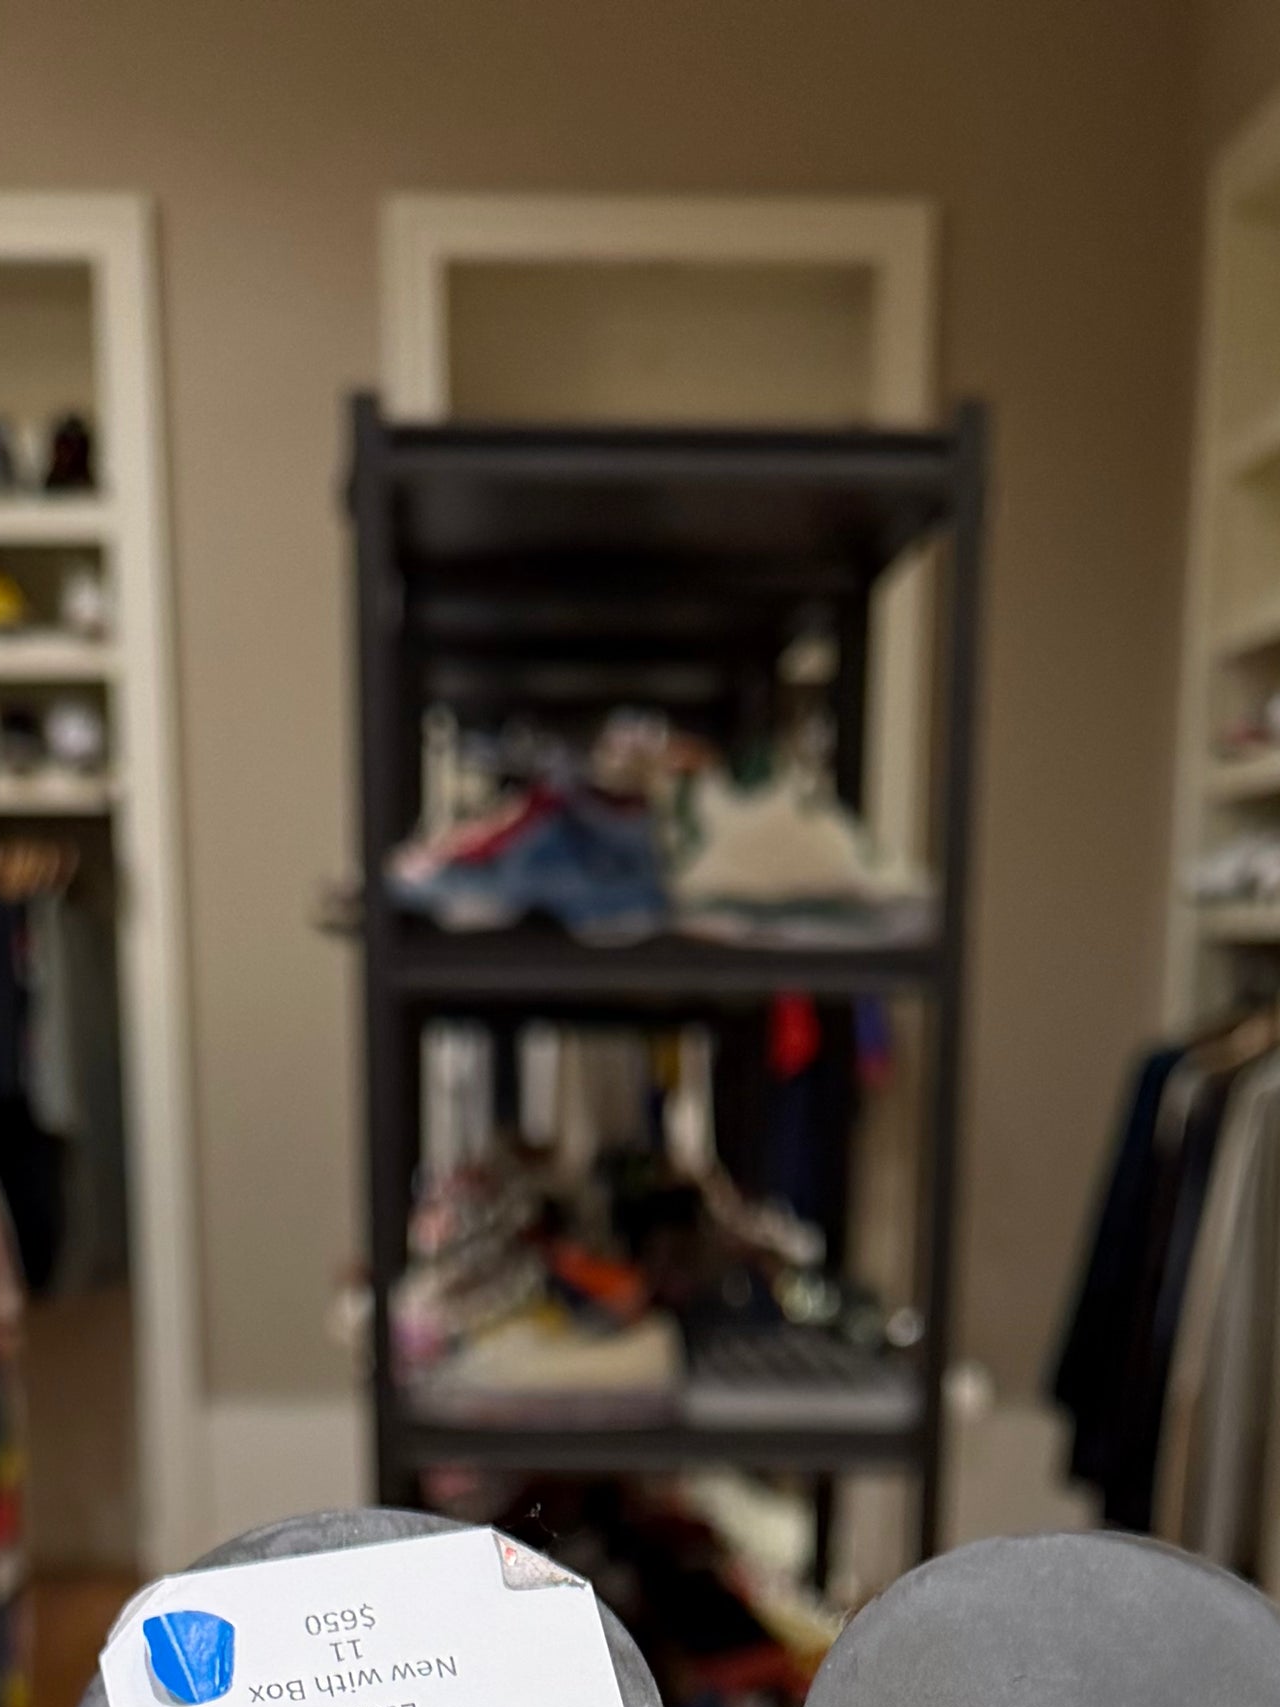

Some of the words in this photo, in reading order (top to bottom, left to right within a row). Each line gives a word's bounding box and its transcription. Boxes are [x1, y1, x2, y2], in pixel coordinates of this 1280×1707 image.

[304, 1604, 376, 1636] $650
[329, 1638, 363, 1662] 11
[314, 1667, 383, 1699] with
[392, 1655, 458, 1683] New
[249, 1678, 304, 1705] Box
